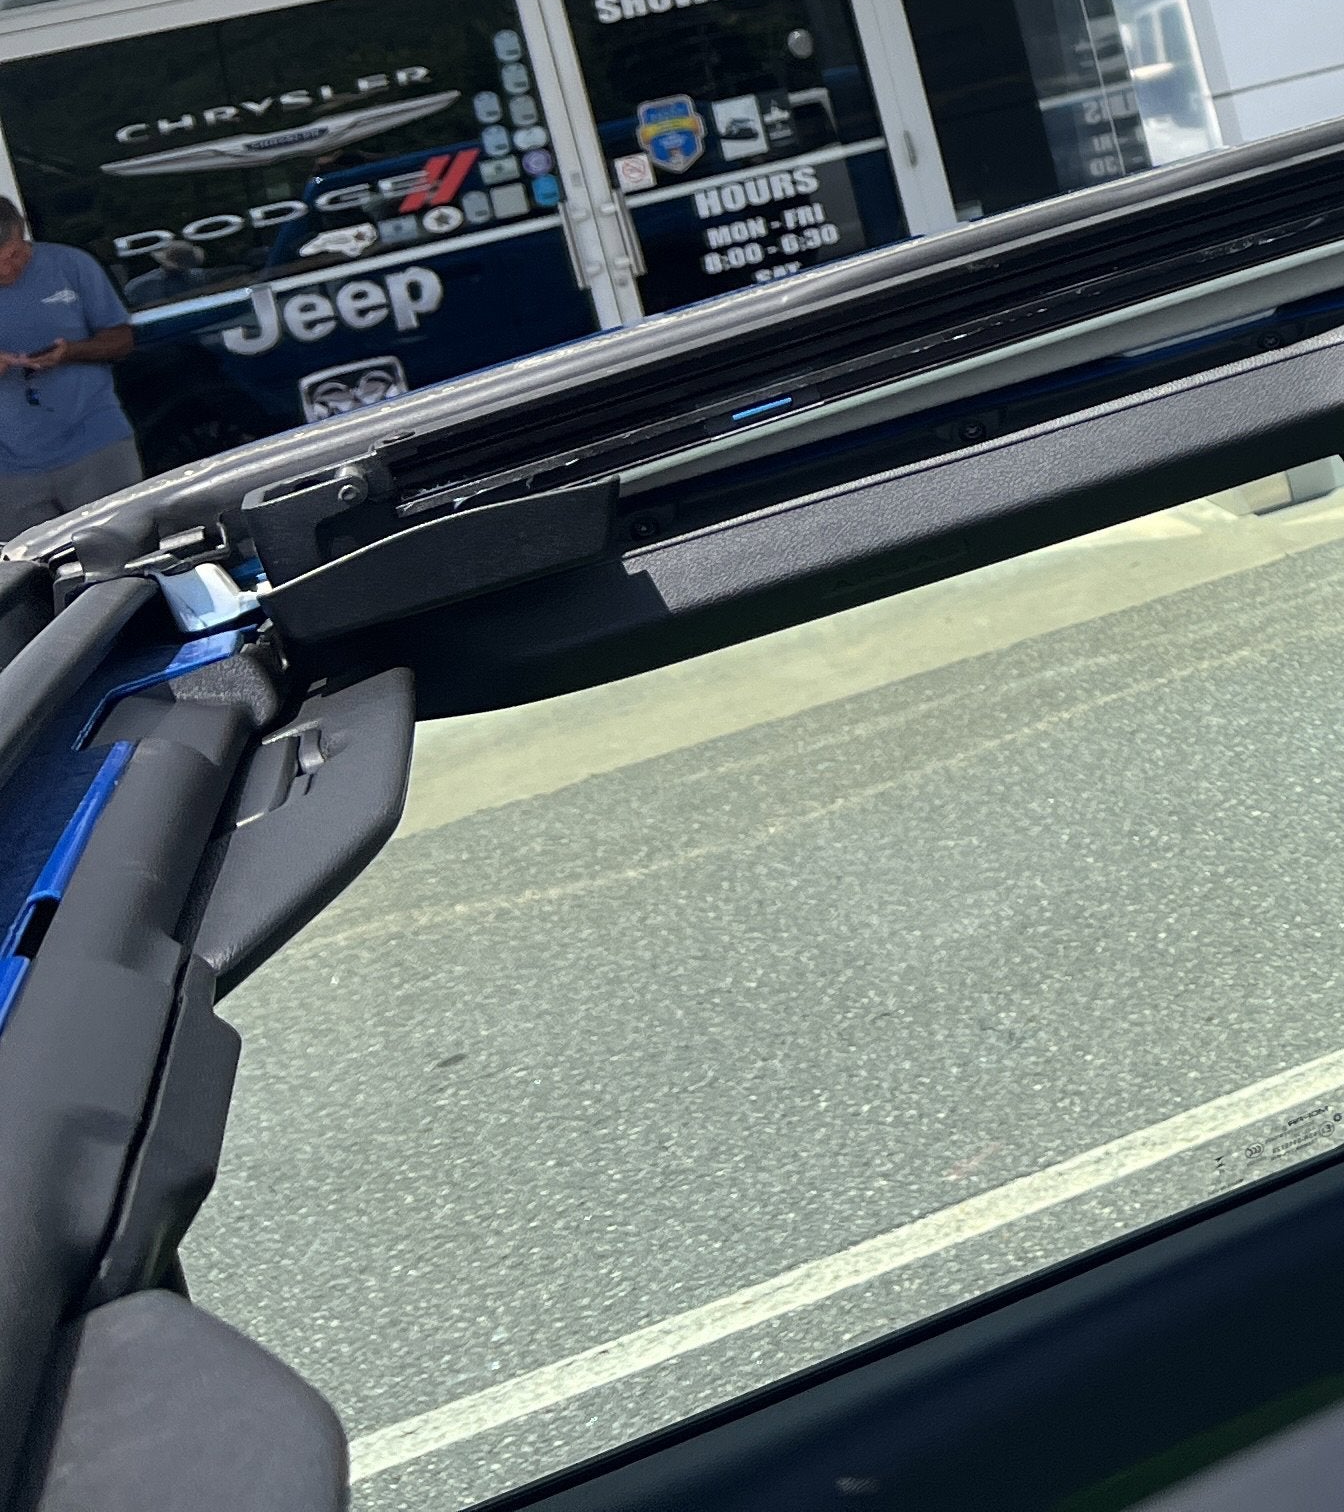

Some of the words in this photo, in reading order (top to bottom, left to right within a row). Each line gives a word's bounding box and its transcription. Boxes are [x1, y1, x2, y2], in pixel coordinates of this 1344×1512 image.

[116, 66, 431, 143] CHRYSLER
[114, 170, 430, 257] DODGE
[695, 165, 819, 219] HOURS
[706, 216, 769, 249] MON
[783, 202, 826, 230] FRI
[222, 266, 443, 355] Jeep
